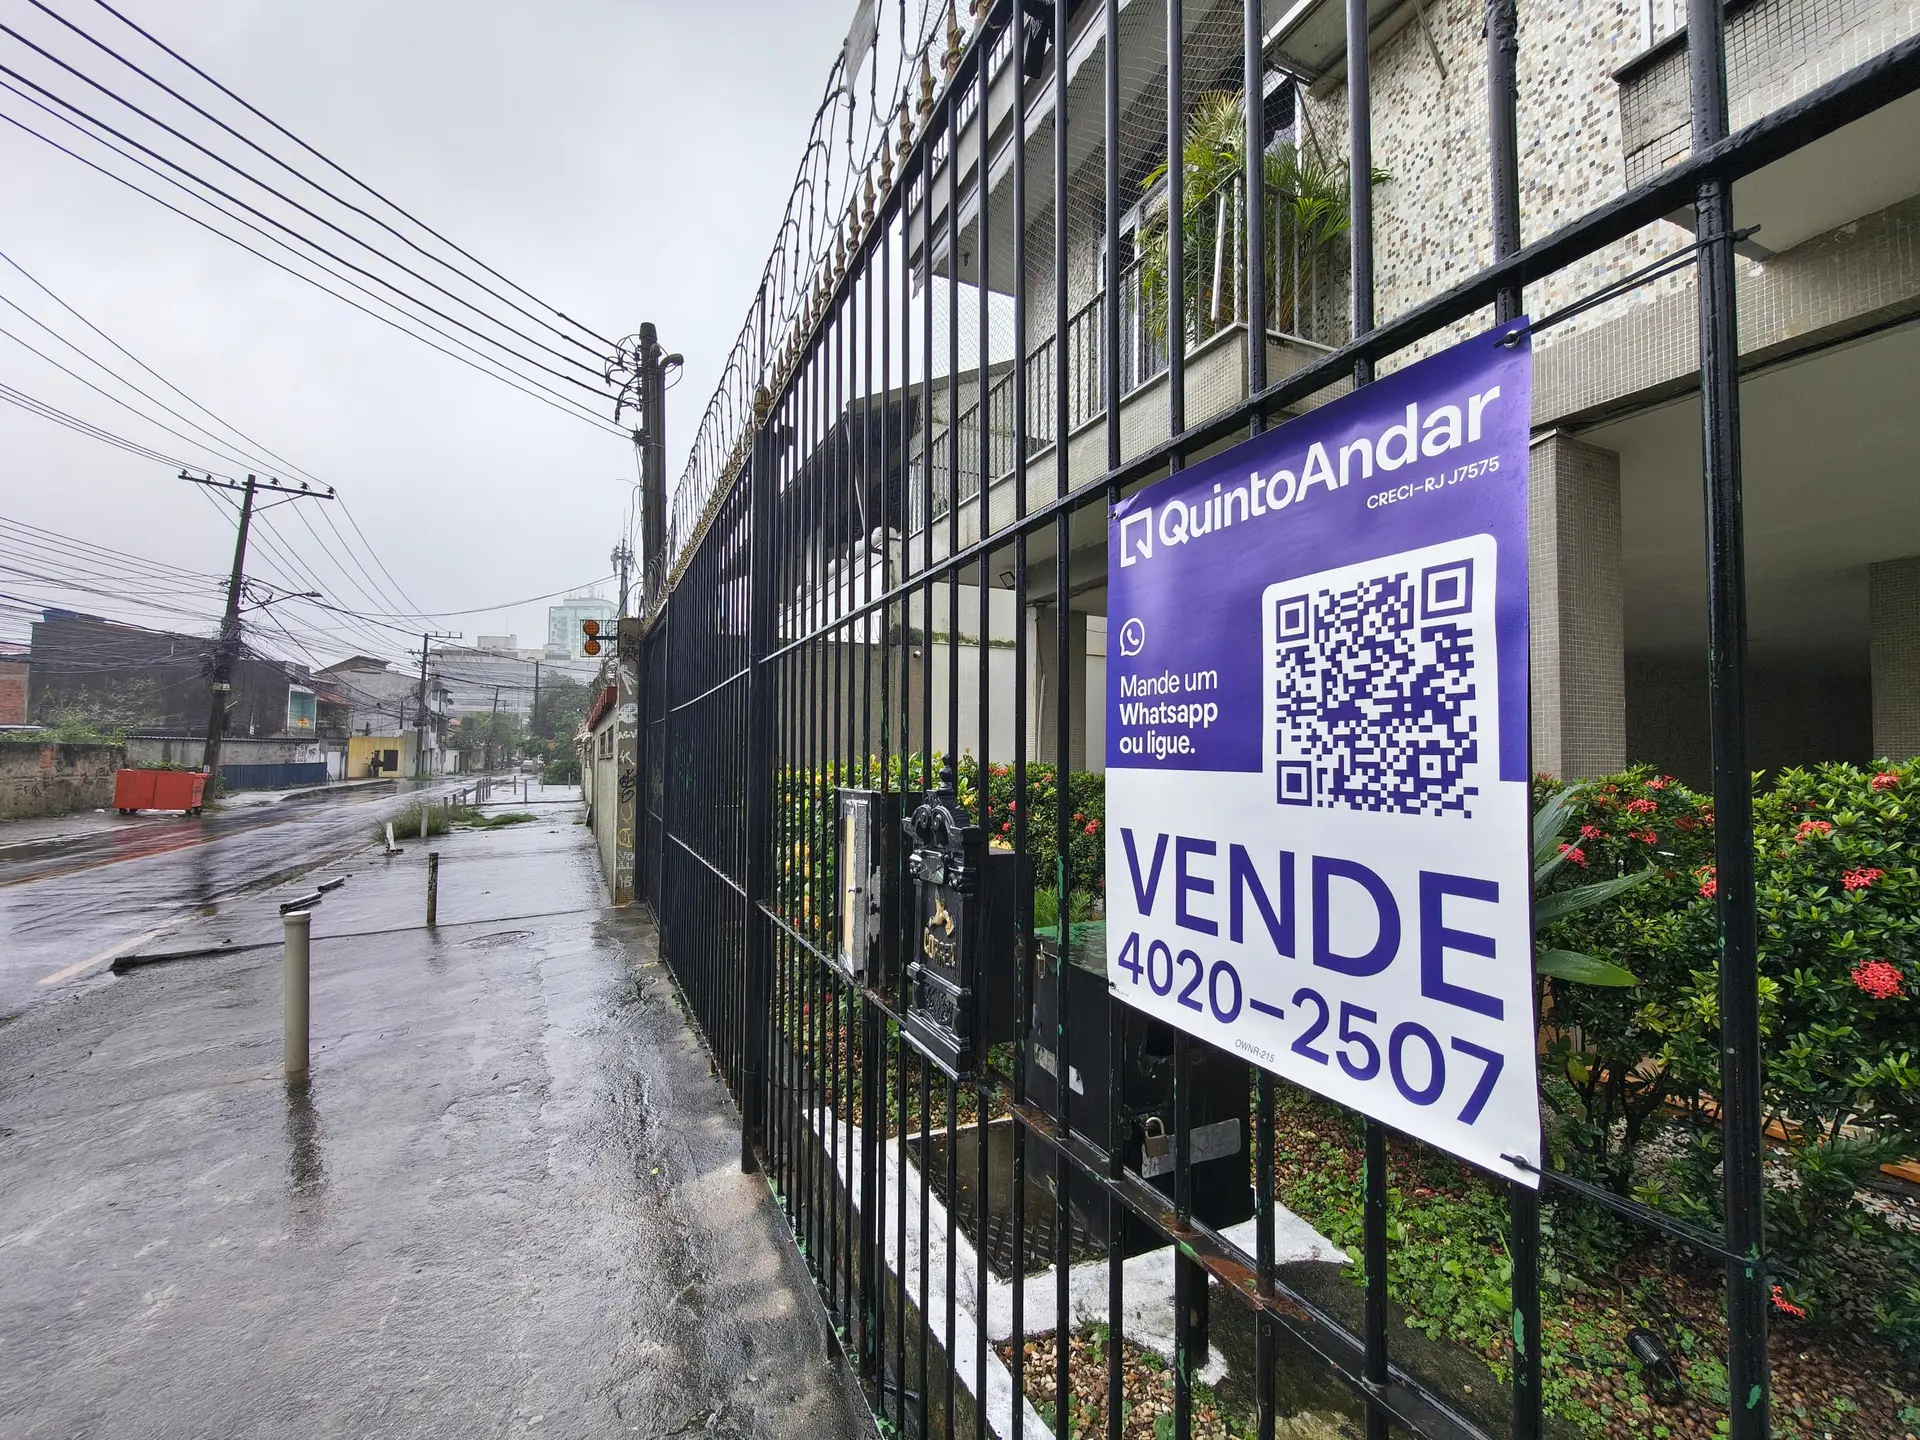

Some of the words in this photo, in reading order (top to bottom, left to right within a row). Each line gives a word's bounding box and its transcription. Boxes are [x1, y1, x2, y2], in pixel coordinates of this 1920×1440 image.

[1159, 385, 1500, 547] QuintoAndar
[1366, 472, 1445, 510] CRECI-RJ
[1448, 455, 1500, 487] J7575
[1120, 669, 1180, 698] Mande
[1184, 669, 1218, 692] um
[1119, 701, 1219, 729] Whatsapp
[1119, 736, 1143, 754] ou
[1146, 729, 1196, 760] ligue.
[1119, 827, 1504, 1021] VENDE
[1118, 932, 1504, 1126] 4020-2507
[1235, 1038, 1276, 1063] OWNR-215
